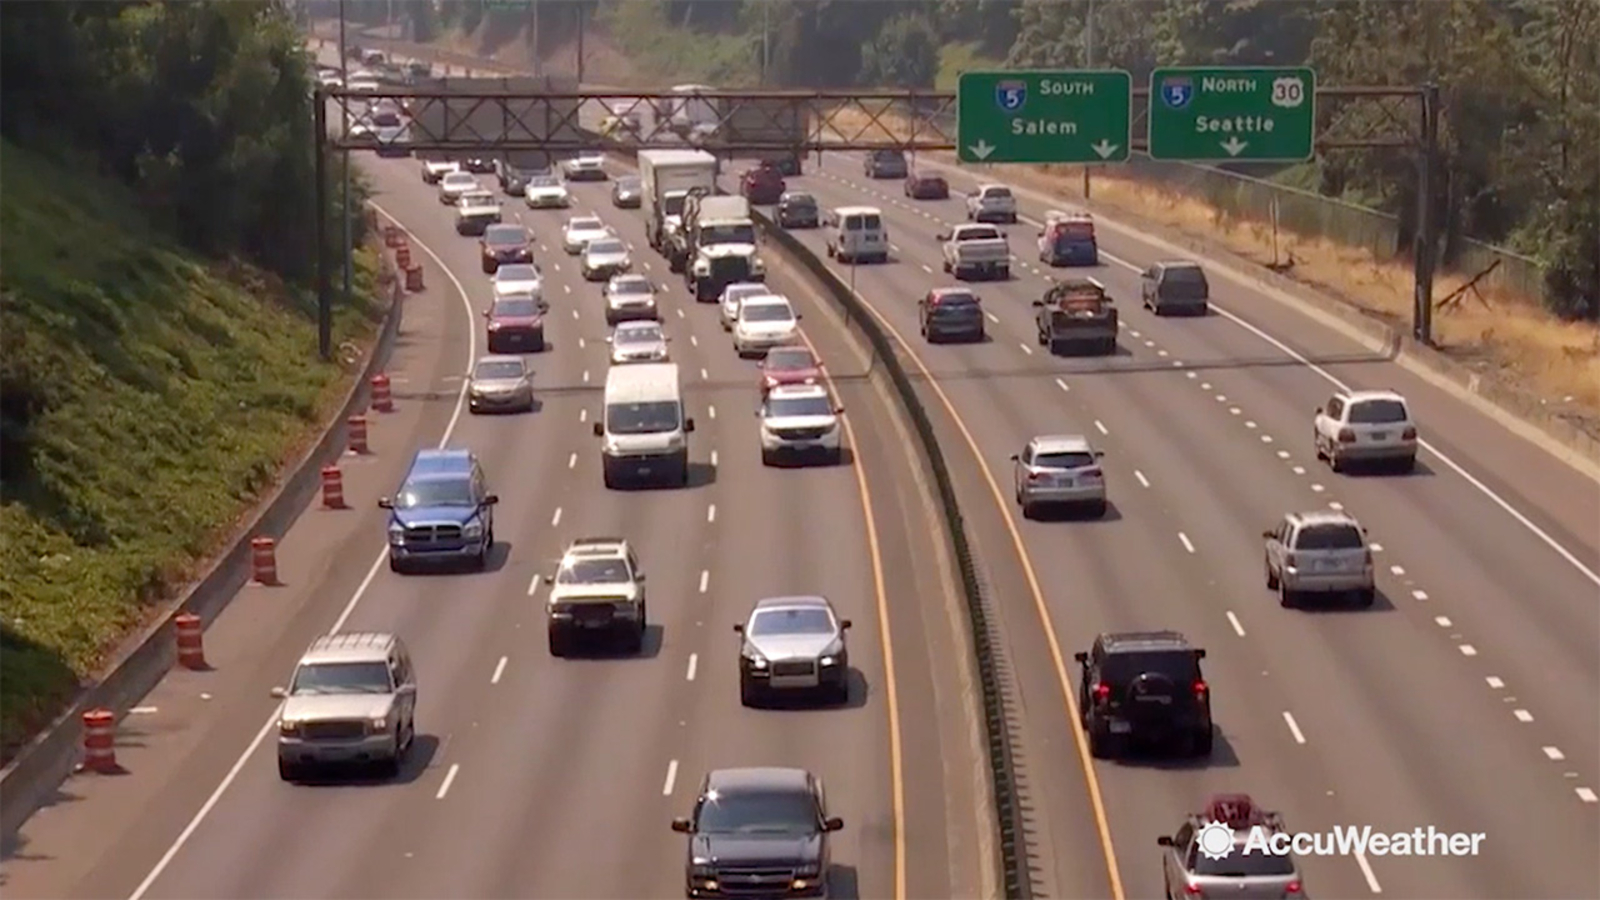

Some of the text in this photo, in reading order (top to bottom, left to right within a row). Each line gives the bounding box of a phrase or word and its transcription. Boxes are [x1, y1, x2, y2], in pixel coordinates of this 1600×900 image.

[1040, 79, 1094, 95] SOUTH
[1202, 77, 1257, 92] NORTH
[1275, 83, 1300, 100] 30
[1006, 89, 1019, 108] 5
[1171, 86, 1184, 105] 5
[1012, 118, 1077, 135] Salem
[1195, 116, 1274, 132] Seattle
